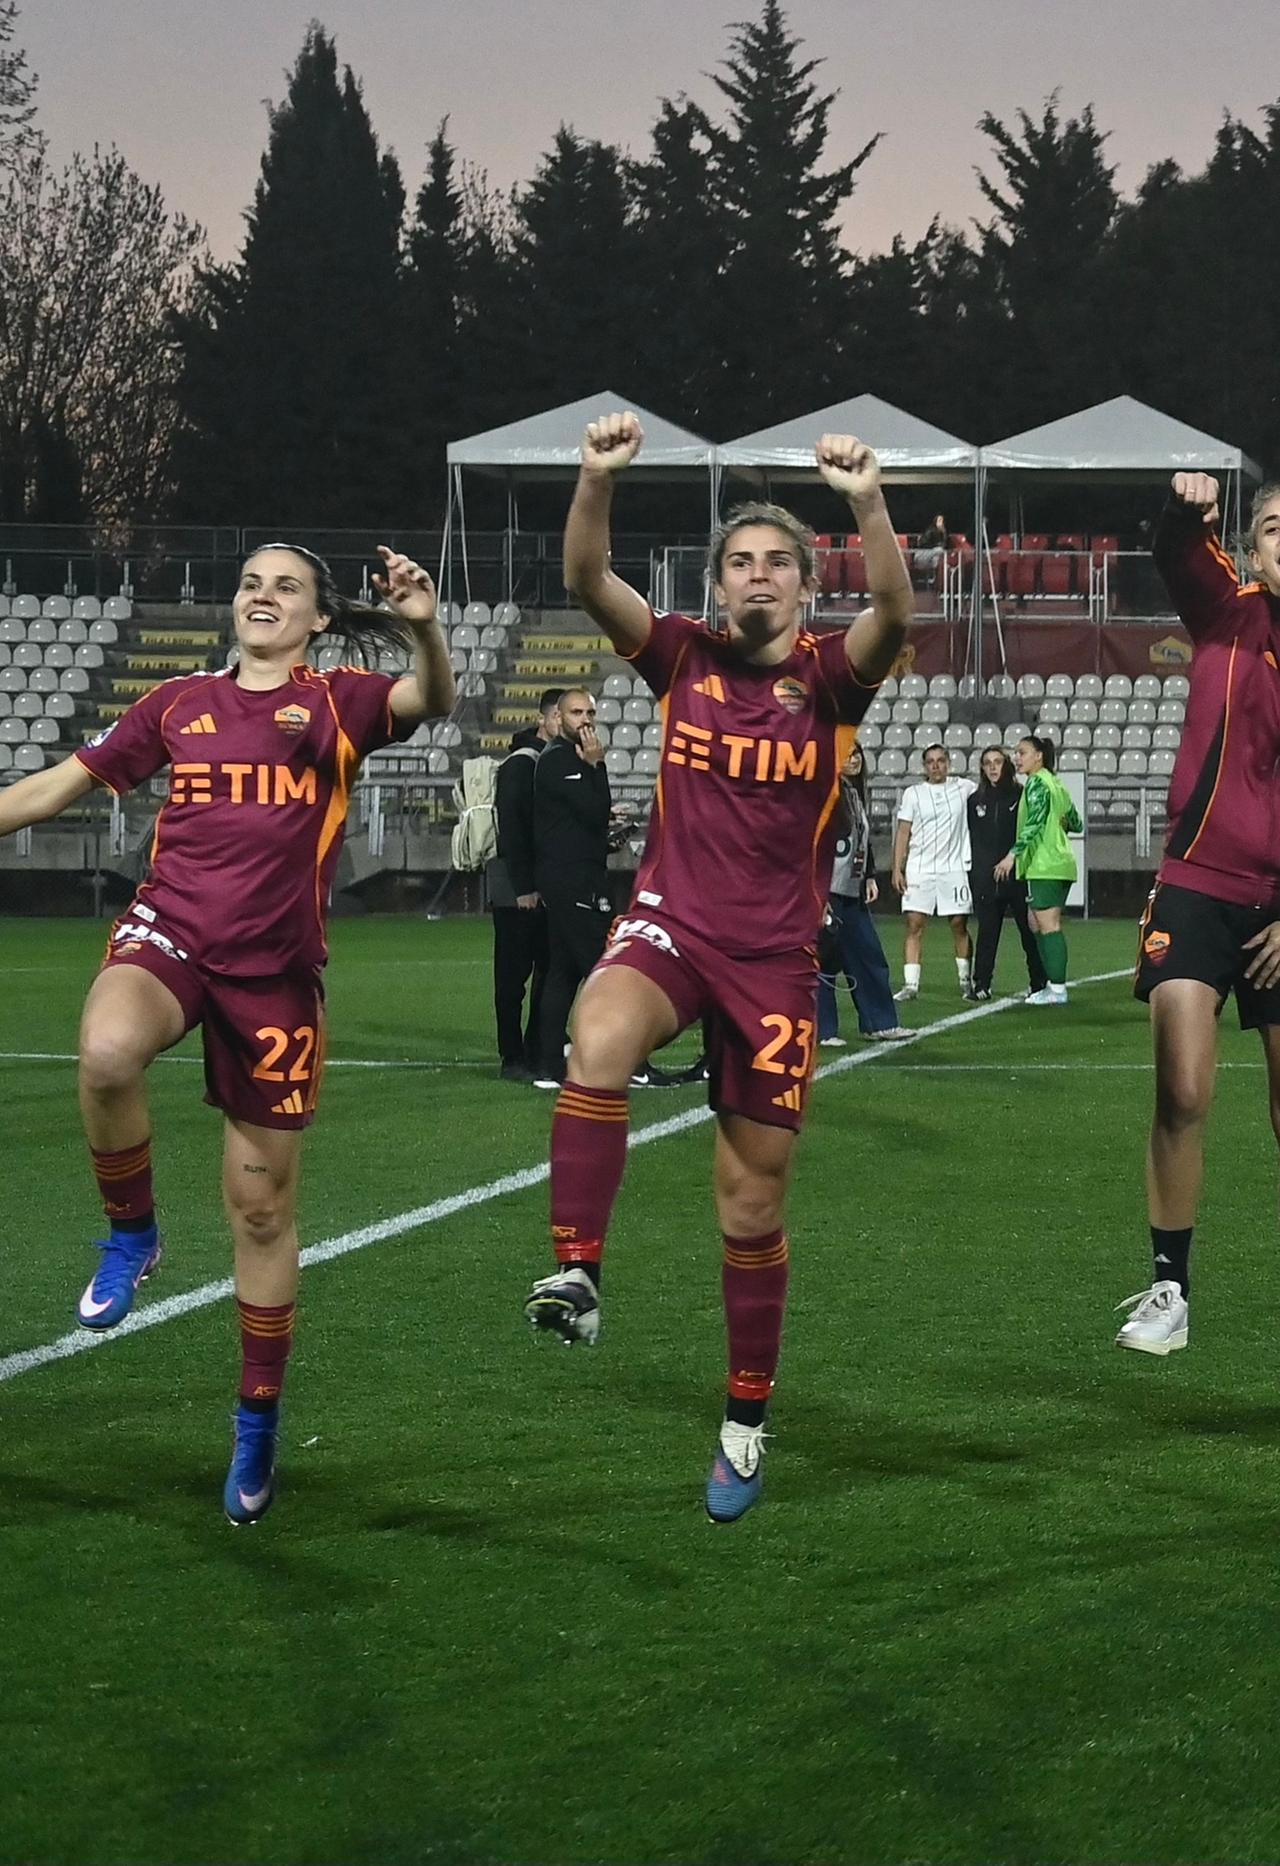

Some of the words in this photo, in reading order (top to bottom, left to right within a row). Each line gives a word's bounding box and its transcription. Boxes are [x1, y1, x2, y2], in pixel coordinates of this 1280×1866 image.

[720, 733, 817, 782] TIM
[221, 763, 317, 805] TIM
[952, 885, 970, 903] 10
[253, 1026, 314, 1082] 22
[751, 1013, 813, 1078] 23
